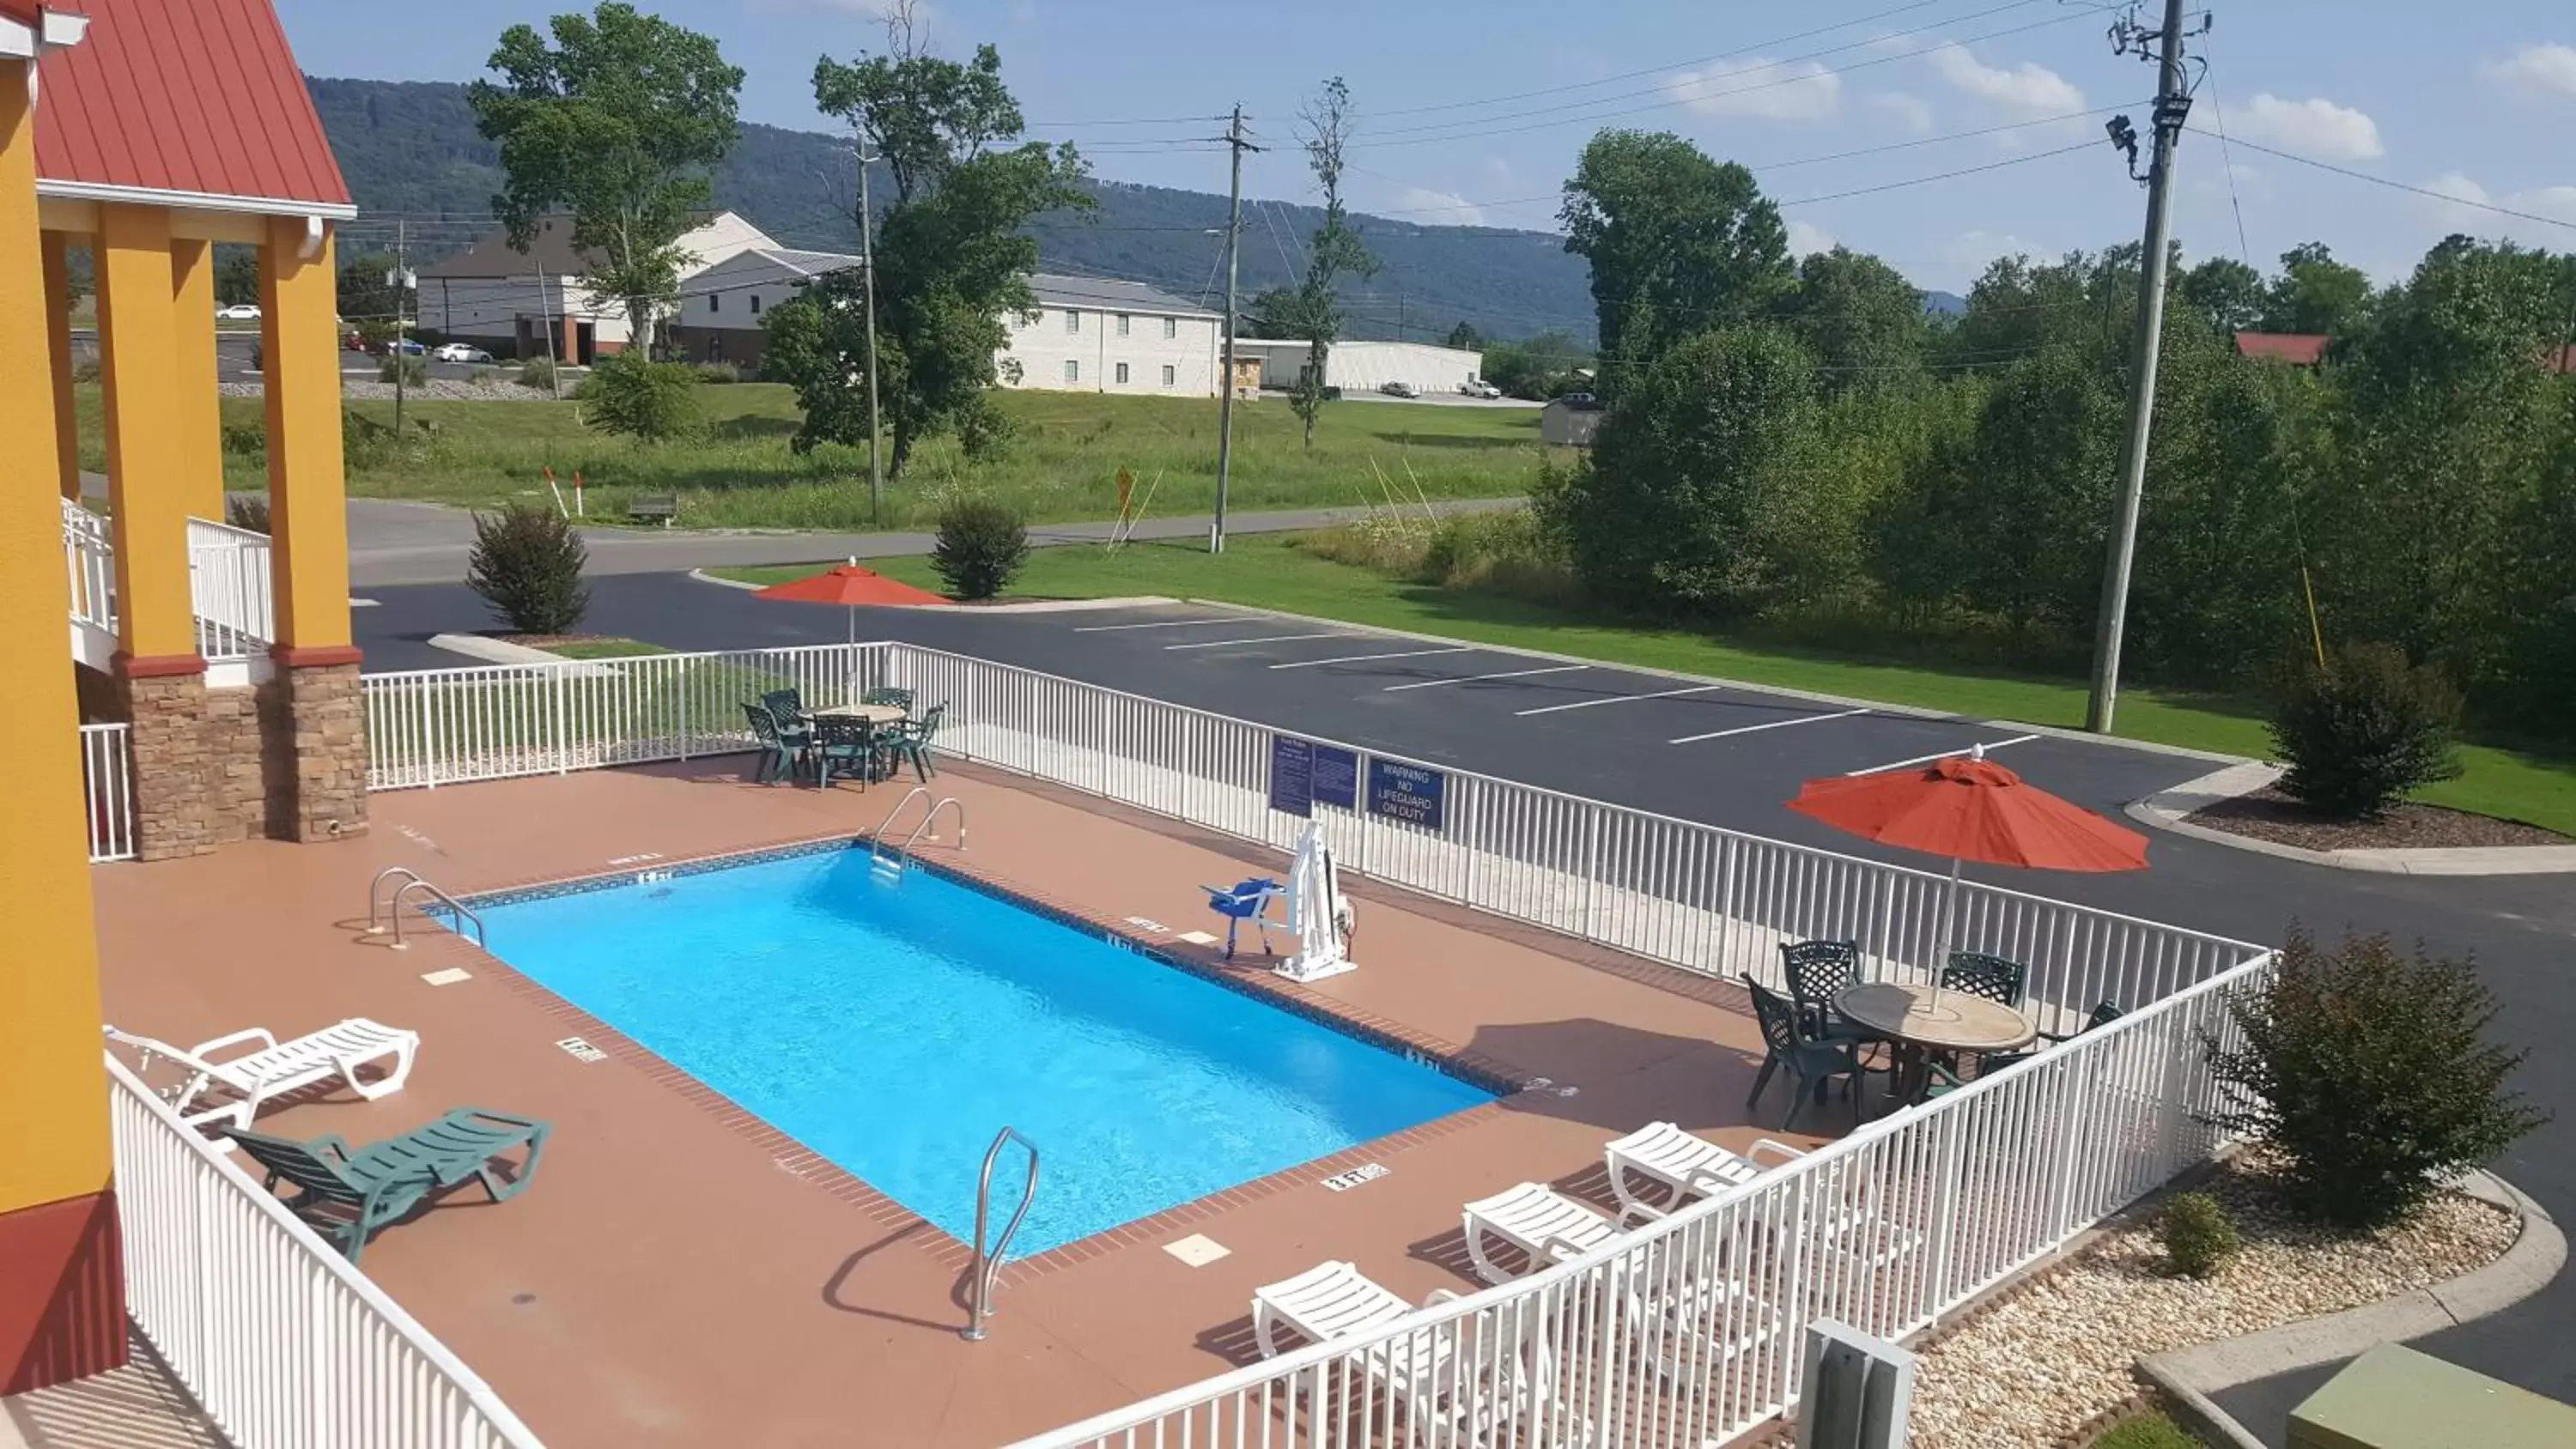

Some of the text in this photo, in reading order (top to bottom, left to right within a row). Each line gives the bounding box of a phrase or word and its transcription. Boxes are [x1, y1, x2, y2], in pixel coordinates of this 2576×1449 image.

[1382, 763, 1430, 784] WARNING
[1397, 779, 1413, 792] NO
[1378, 786, 1431, 809] LIFEGUARD
[1382, 801, 1425, 822] ON DUTY
[1328, 1169, 1369, 1188] 3 FT
